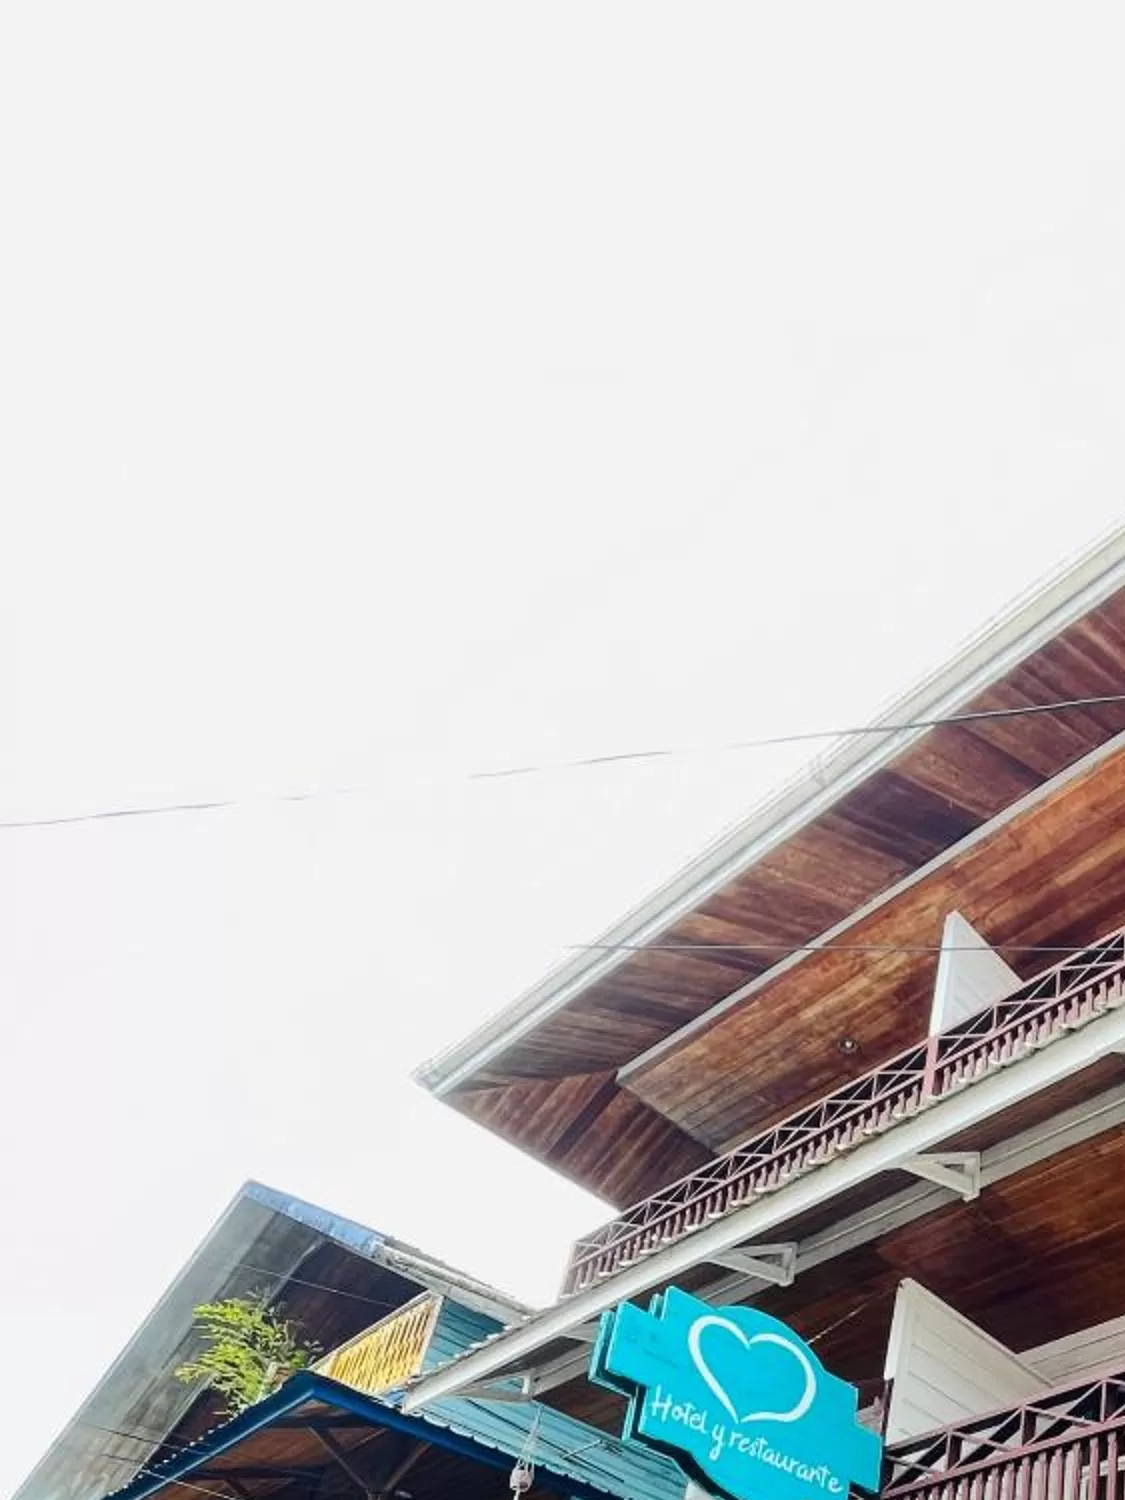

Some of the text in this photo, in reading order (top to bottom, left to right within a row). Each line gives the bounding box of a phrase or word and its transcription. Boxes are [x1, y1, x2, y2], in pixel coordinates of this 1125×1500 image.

[652, 1384, 842, 1493] Hotel y restaurante
